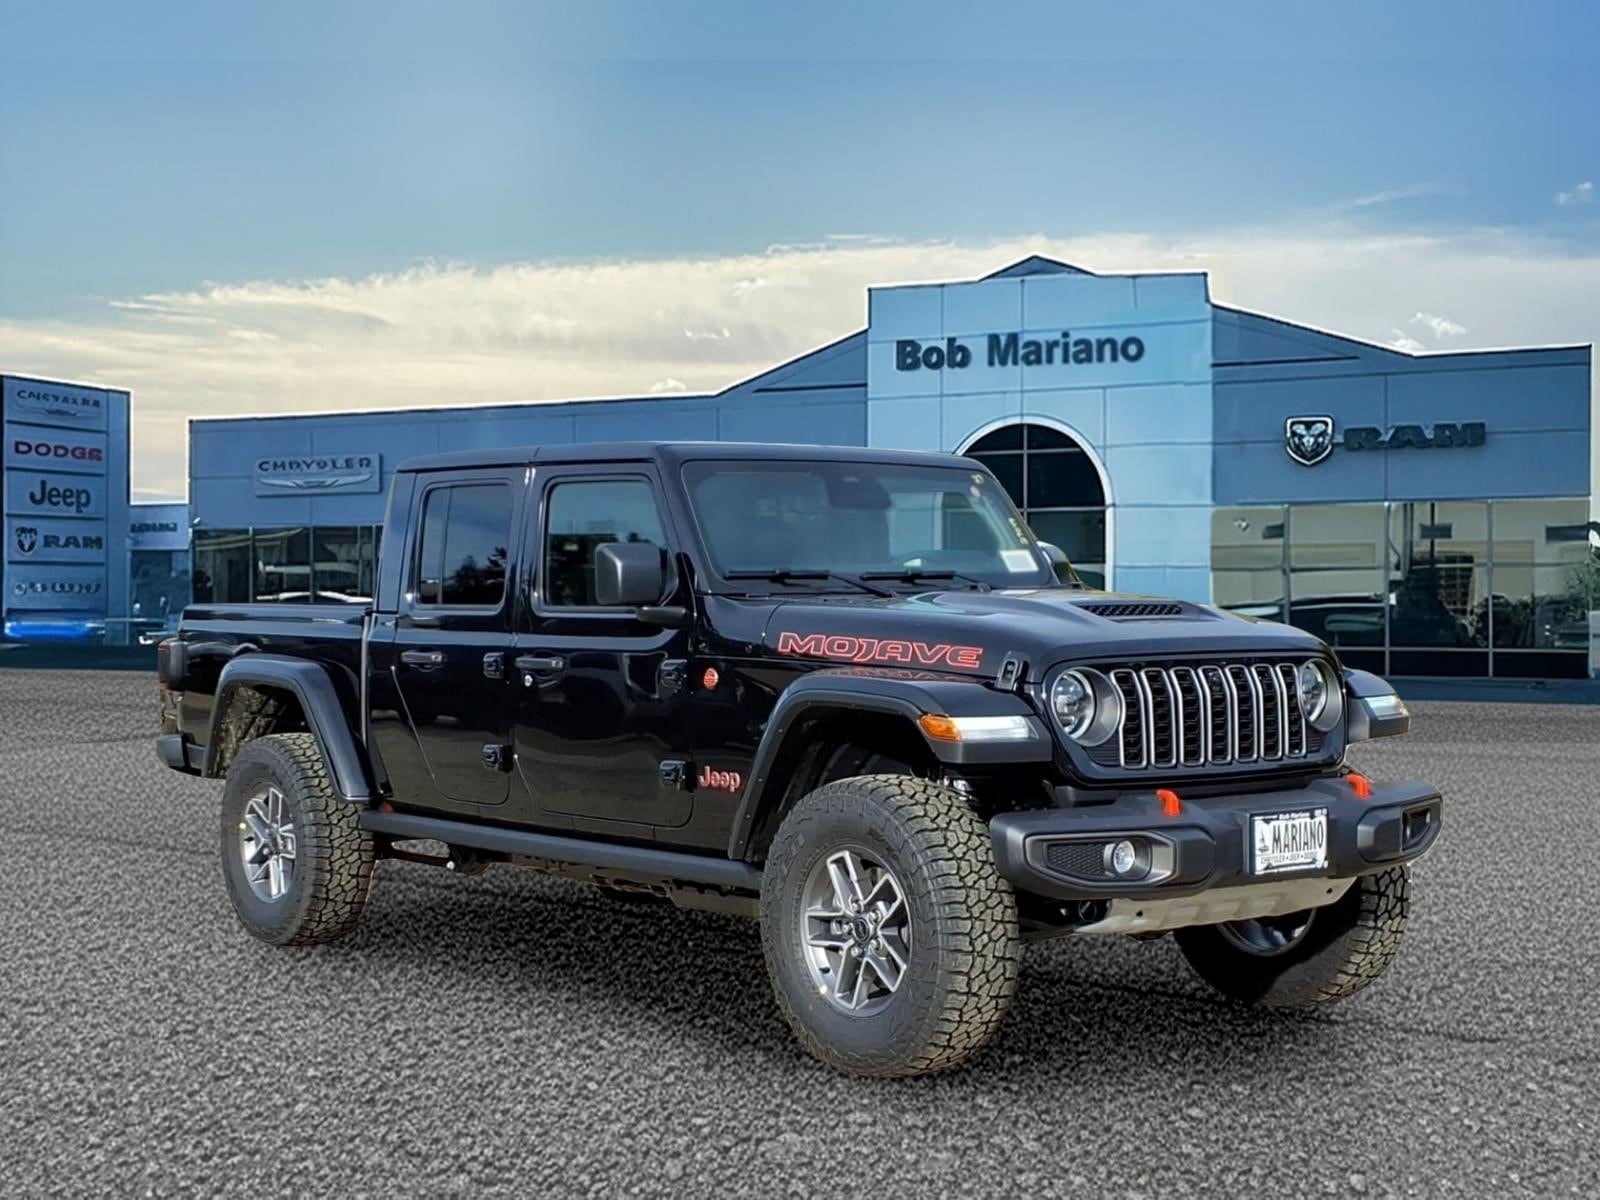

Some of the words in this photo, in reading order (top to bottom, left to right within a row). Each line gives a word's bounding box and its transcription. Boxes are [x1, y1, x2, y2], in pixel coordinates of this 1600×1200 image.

[895, 337, 972, 372] Bob
[987, 331, 1146, 368] Mariano
[14, 440, 103, 462] DODGE
[1343, 421, 1486, 452] RAM
[257, 456, 373, 472] CHRYSLER
[29, 479, 92, 514] Jeep
[43, 534, 104, 550] RAM
[777, 631, 984, 669] MOJAVE
[697, 764, 741, 793] Jeep
[1271, 819, 1325, 854] MARIANO
